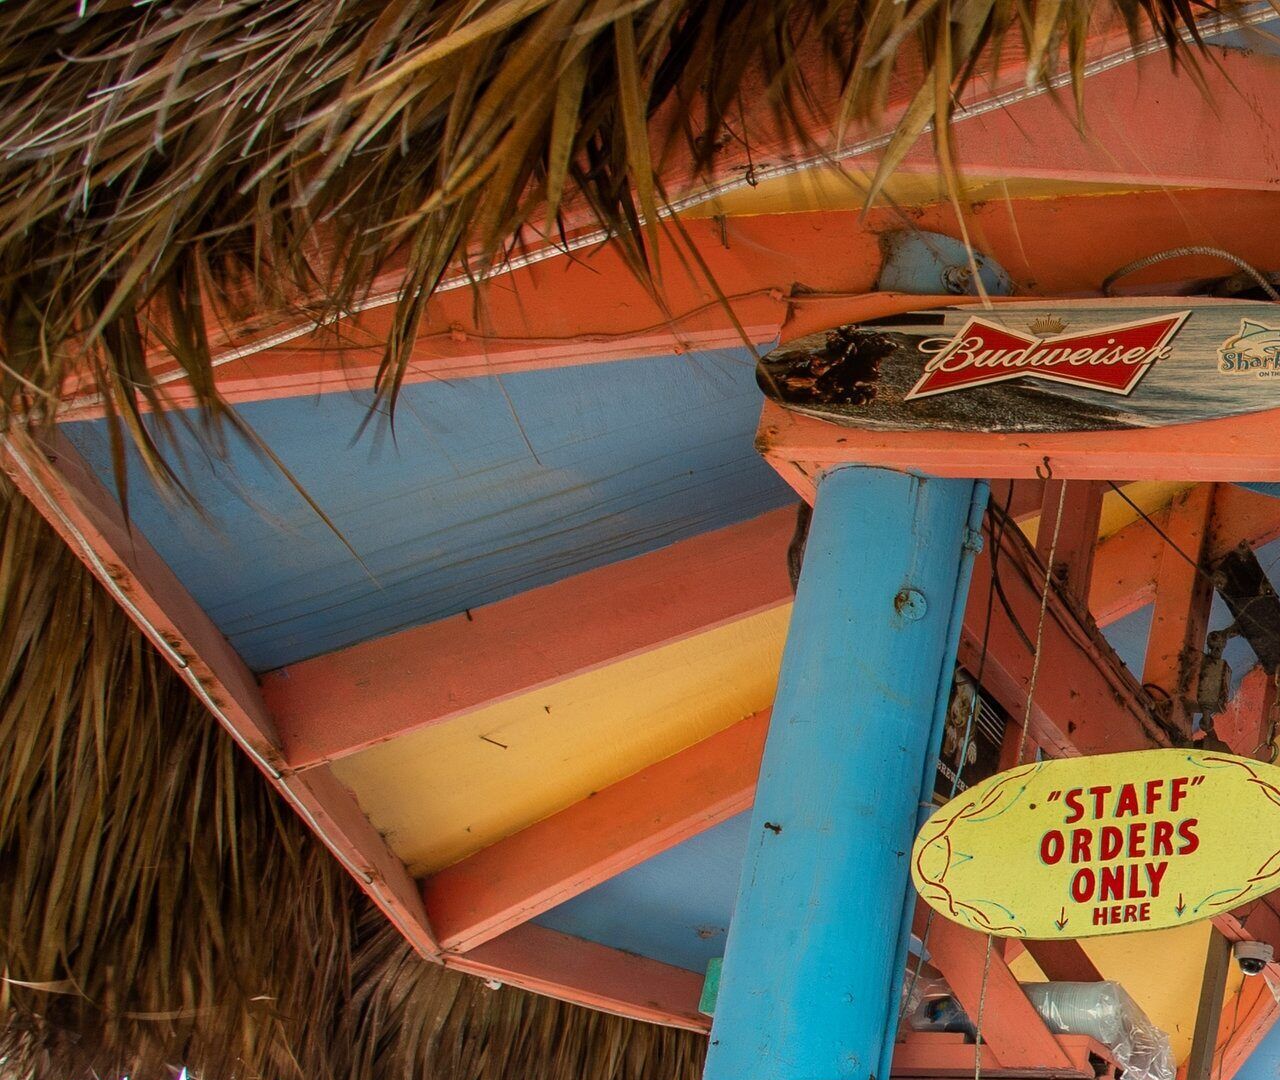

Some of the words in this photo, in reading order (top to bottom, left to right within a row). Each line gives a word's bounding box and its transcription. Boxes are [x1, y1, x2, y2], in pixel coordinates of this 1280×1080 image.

[918, 335, 1172, 374] Budweiser
[1040, 818, 1200, 866] ORDERS
[1071, 861, 1168, 904] ONLY
[1092, 901, 1151, 926] HERE
